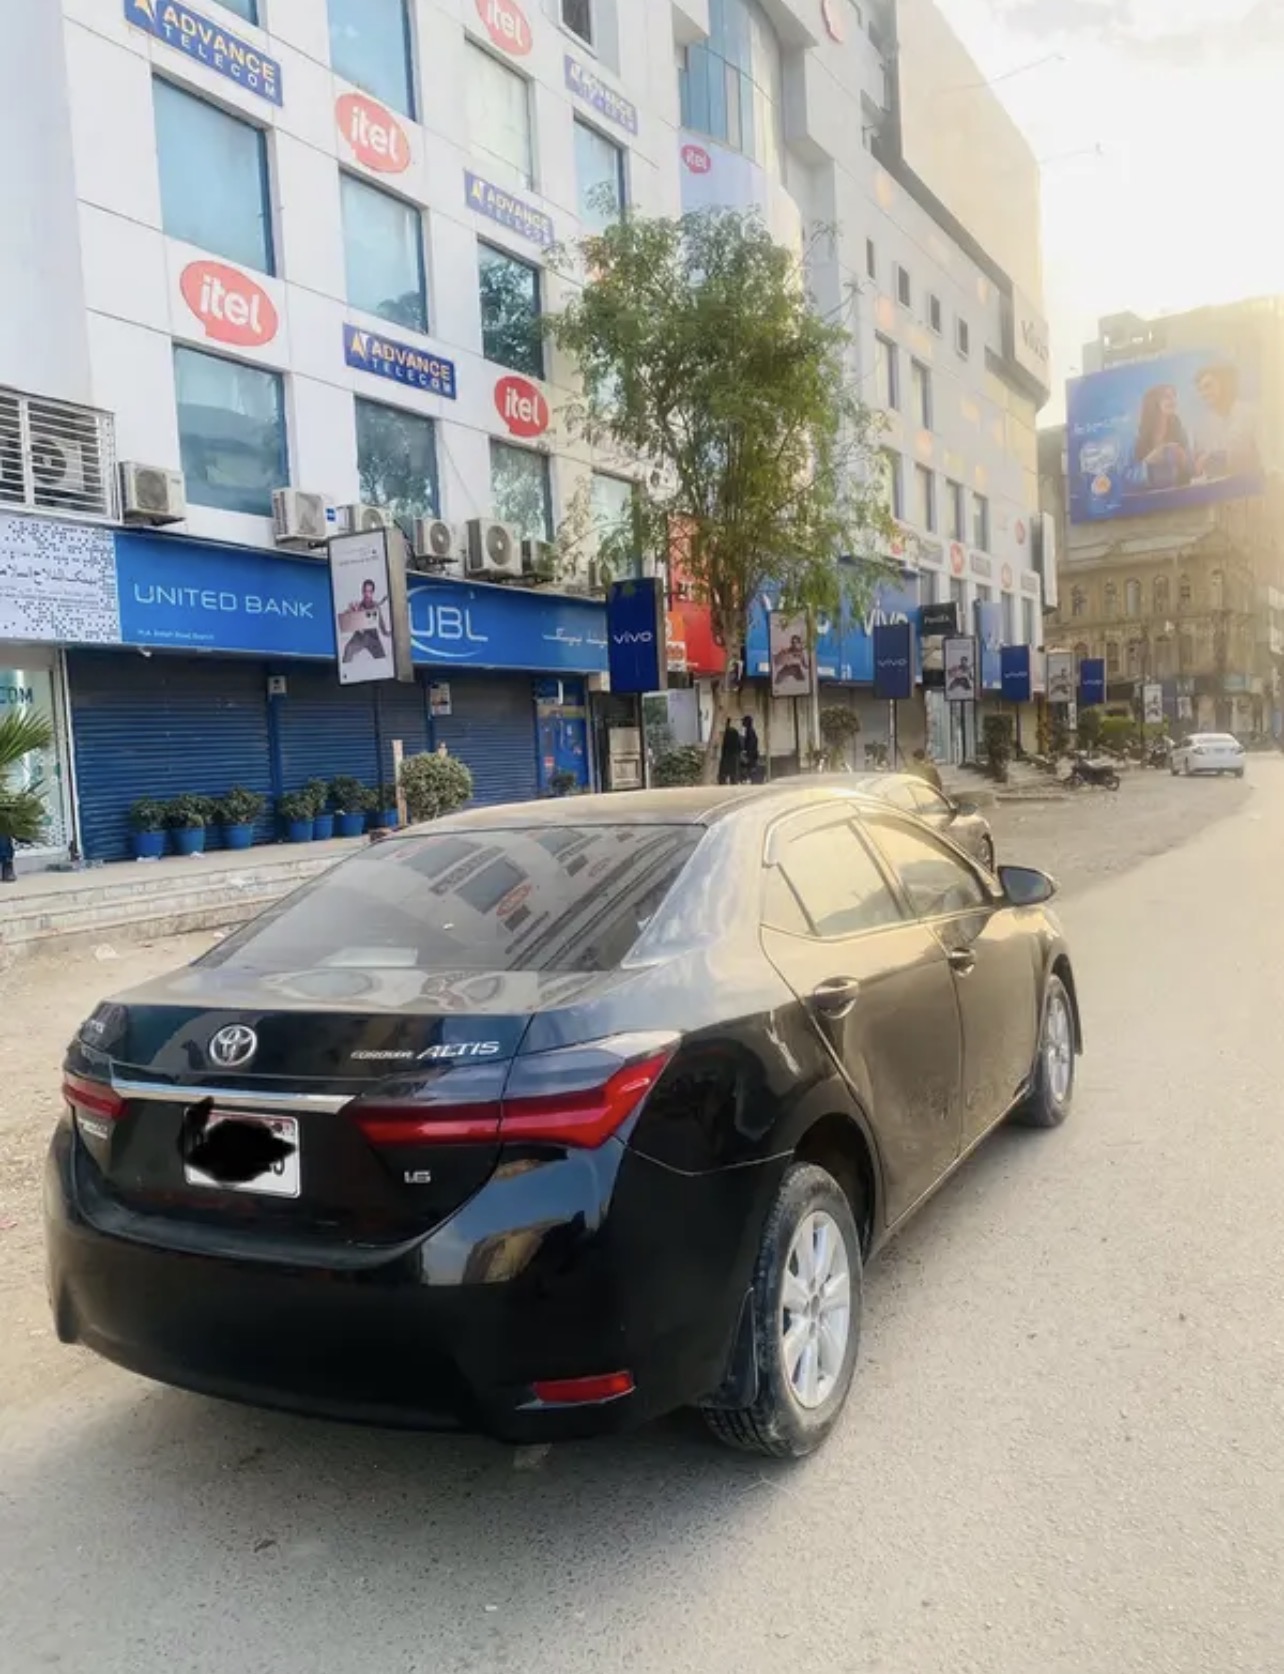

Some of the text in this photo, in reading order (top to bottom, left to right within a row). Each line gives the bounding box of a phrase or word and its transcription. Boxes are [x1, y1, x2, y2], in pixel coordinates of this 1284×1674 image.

[162, 22, 276, 98] TELECOM
[163, 4, 276, 80] ADVANCE
[351, 106, 399, 163] itel
[200, 274, 262, 334] itel
[371, 340, 451, 382] ADVANCE
[371, 357, 451, 394] TELECOM
[505, 387, 540, 427] itel
[133, 583, 314, 619] UNITED BANK
[407, 602, 489, 642] UBL
[613, 630, 653, 645] vivo
[416, 1040, 500, 1060] ALTIS
